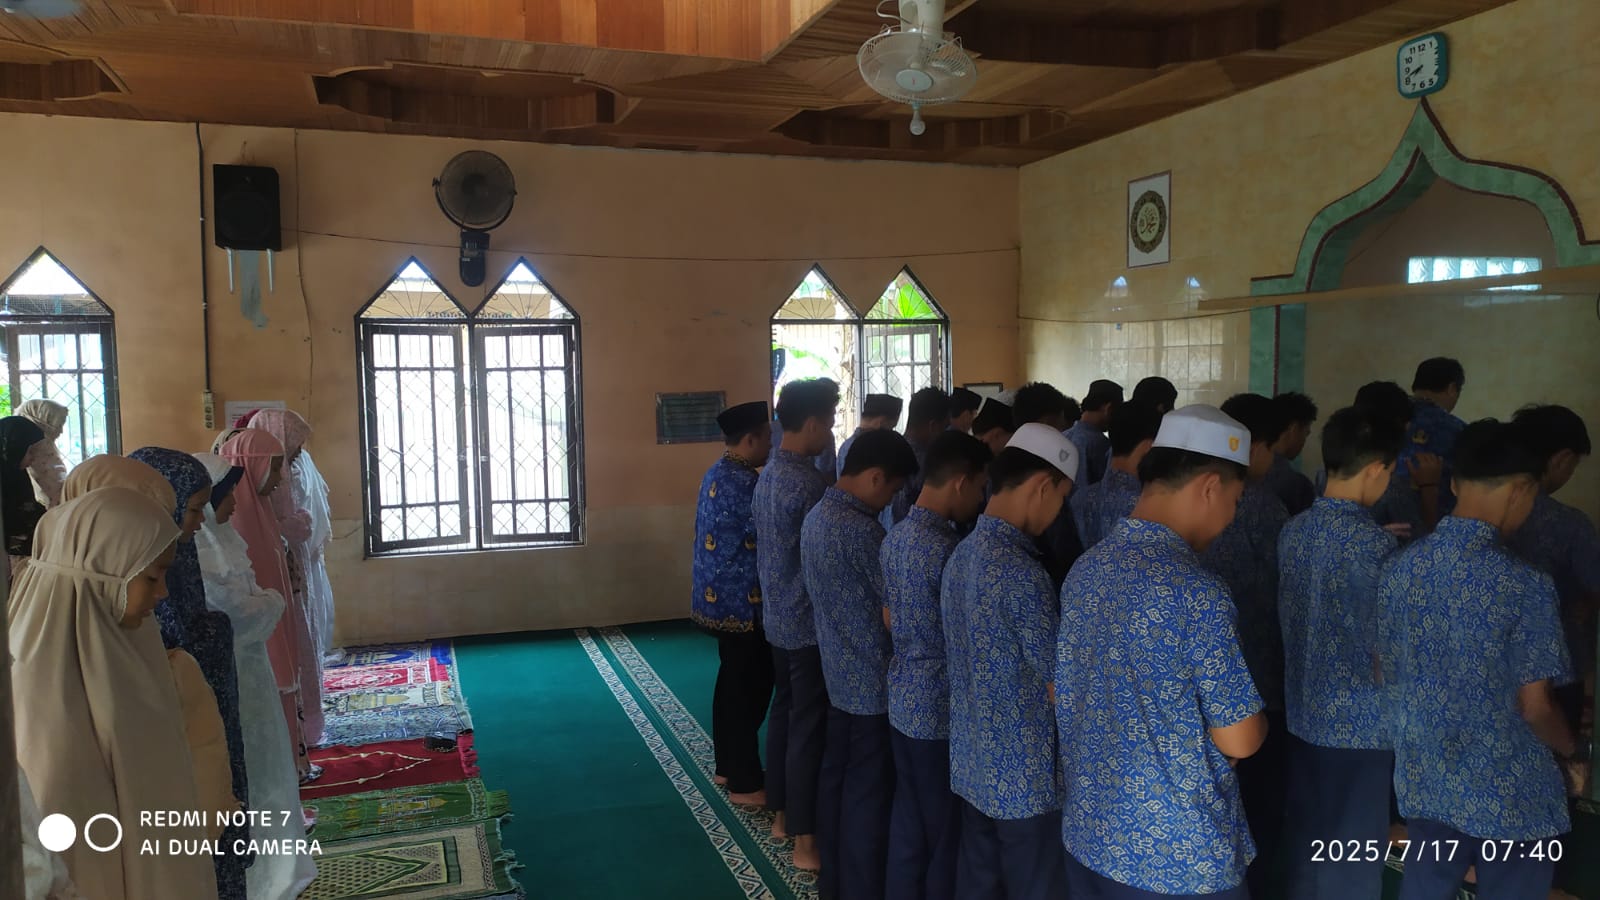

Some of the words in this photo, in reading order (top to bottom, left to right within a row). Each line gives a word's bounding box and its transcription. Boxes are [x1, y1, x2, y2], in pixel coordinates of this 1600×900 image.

[1418, 43, 1426, 52] 12
[1405, 67, 1410, 75] 9
[1420, 80, 1426, 88] 6
